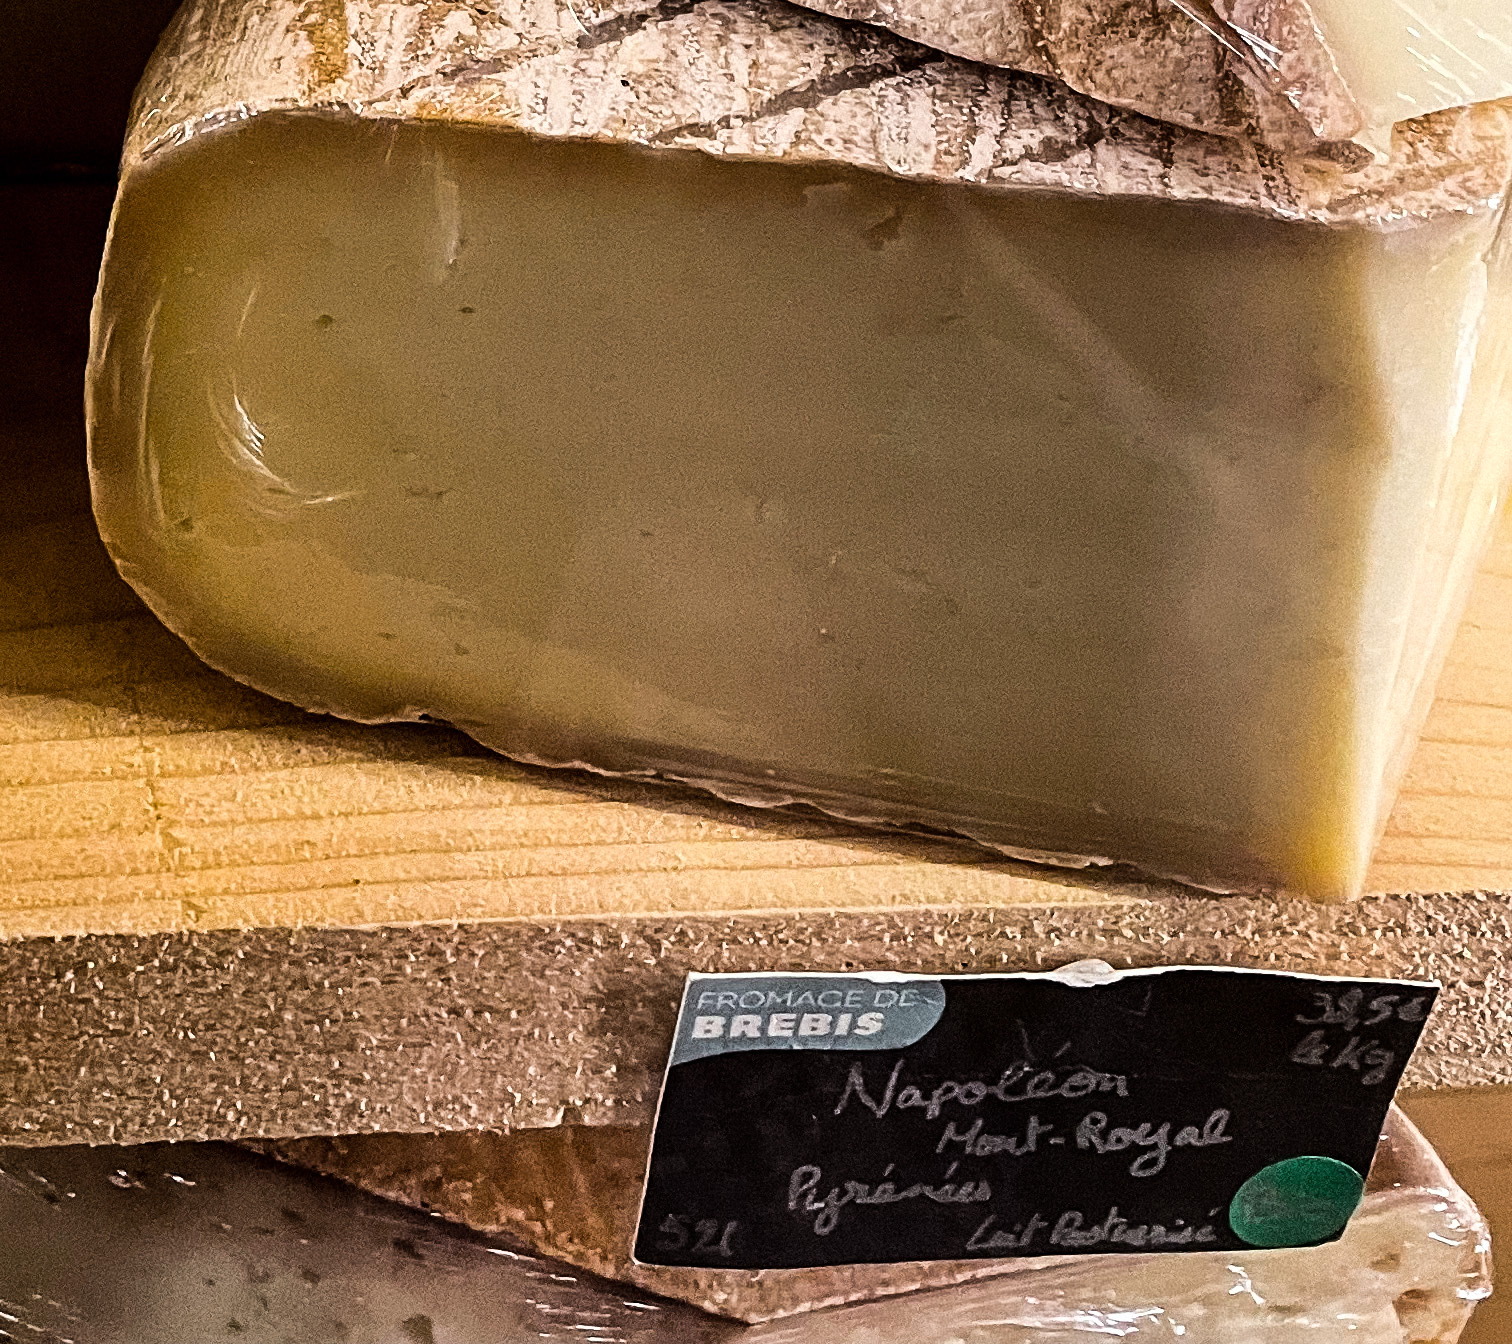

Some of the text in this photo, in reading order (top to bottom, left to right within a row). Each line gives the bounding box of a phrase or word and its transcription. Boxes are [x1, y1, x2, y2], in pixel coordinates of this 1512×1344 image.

[696, 988, 919, 1010] FROMAGE DE
[690, 1012, 886, 1040] BREBIS
